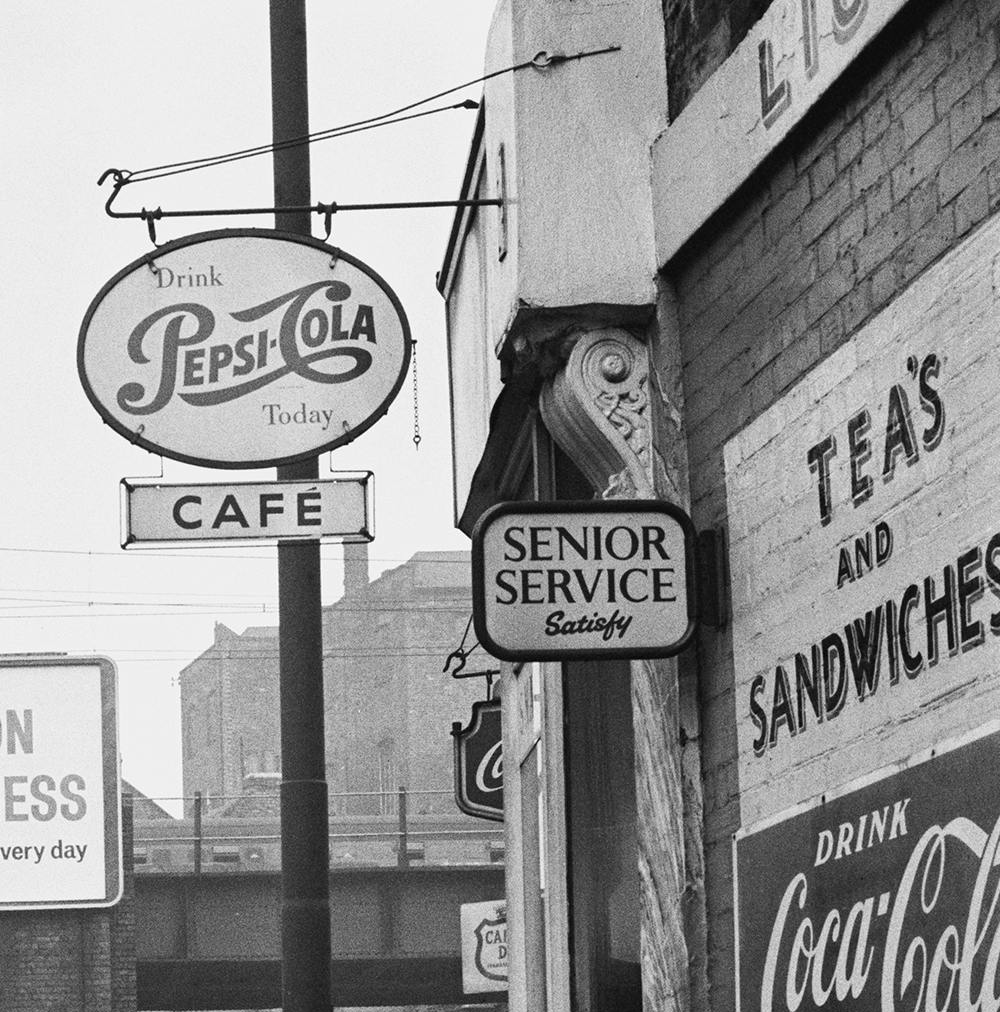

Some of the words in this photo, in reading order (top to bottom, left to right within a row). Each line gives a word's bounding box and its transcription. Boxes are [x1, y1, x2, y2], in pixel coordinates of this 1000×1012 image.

[156, 265, 224, 289] Drink
[262, 402, 334, 431] Today
[807, 353, 946, 528] TEA'S
[173, 487, 322, 530] CAFÉ
[503, 525, 671, 562] SENIOR
[836, 521, 894, 590] AND
[495, 567, 678, 605] SERVICE
[544, 609, 633, 641] Satisfy
[51, 840, 88, 863] day
[814, 798, 911, 868] DRINK
